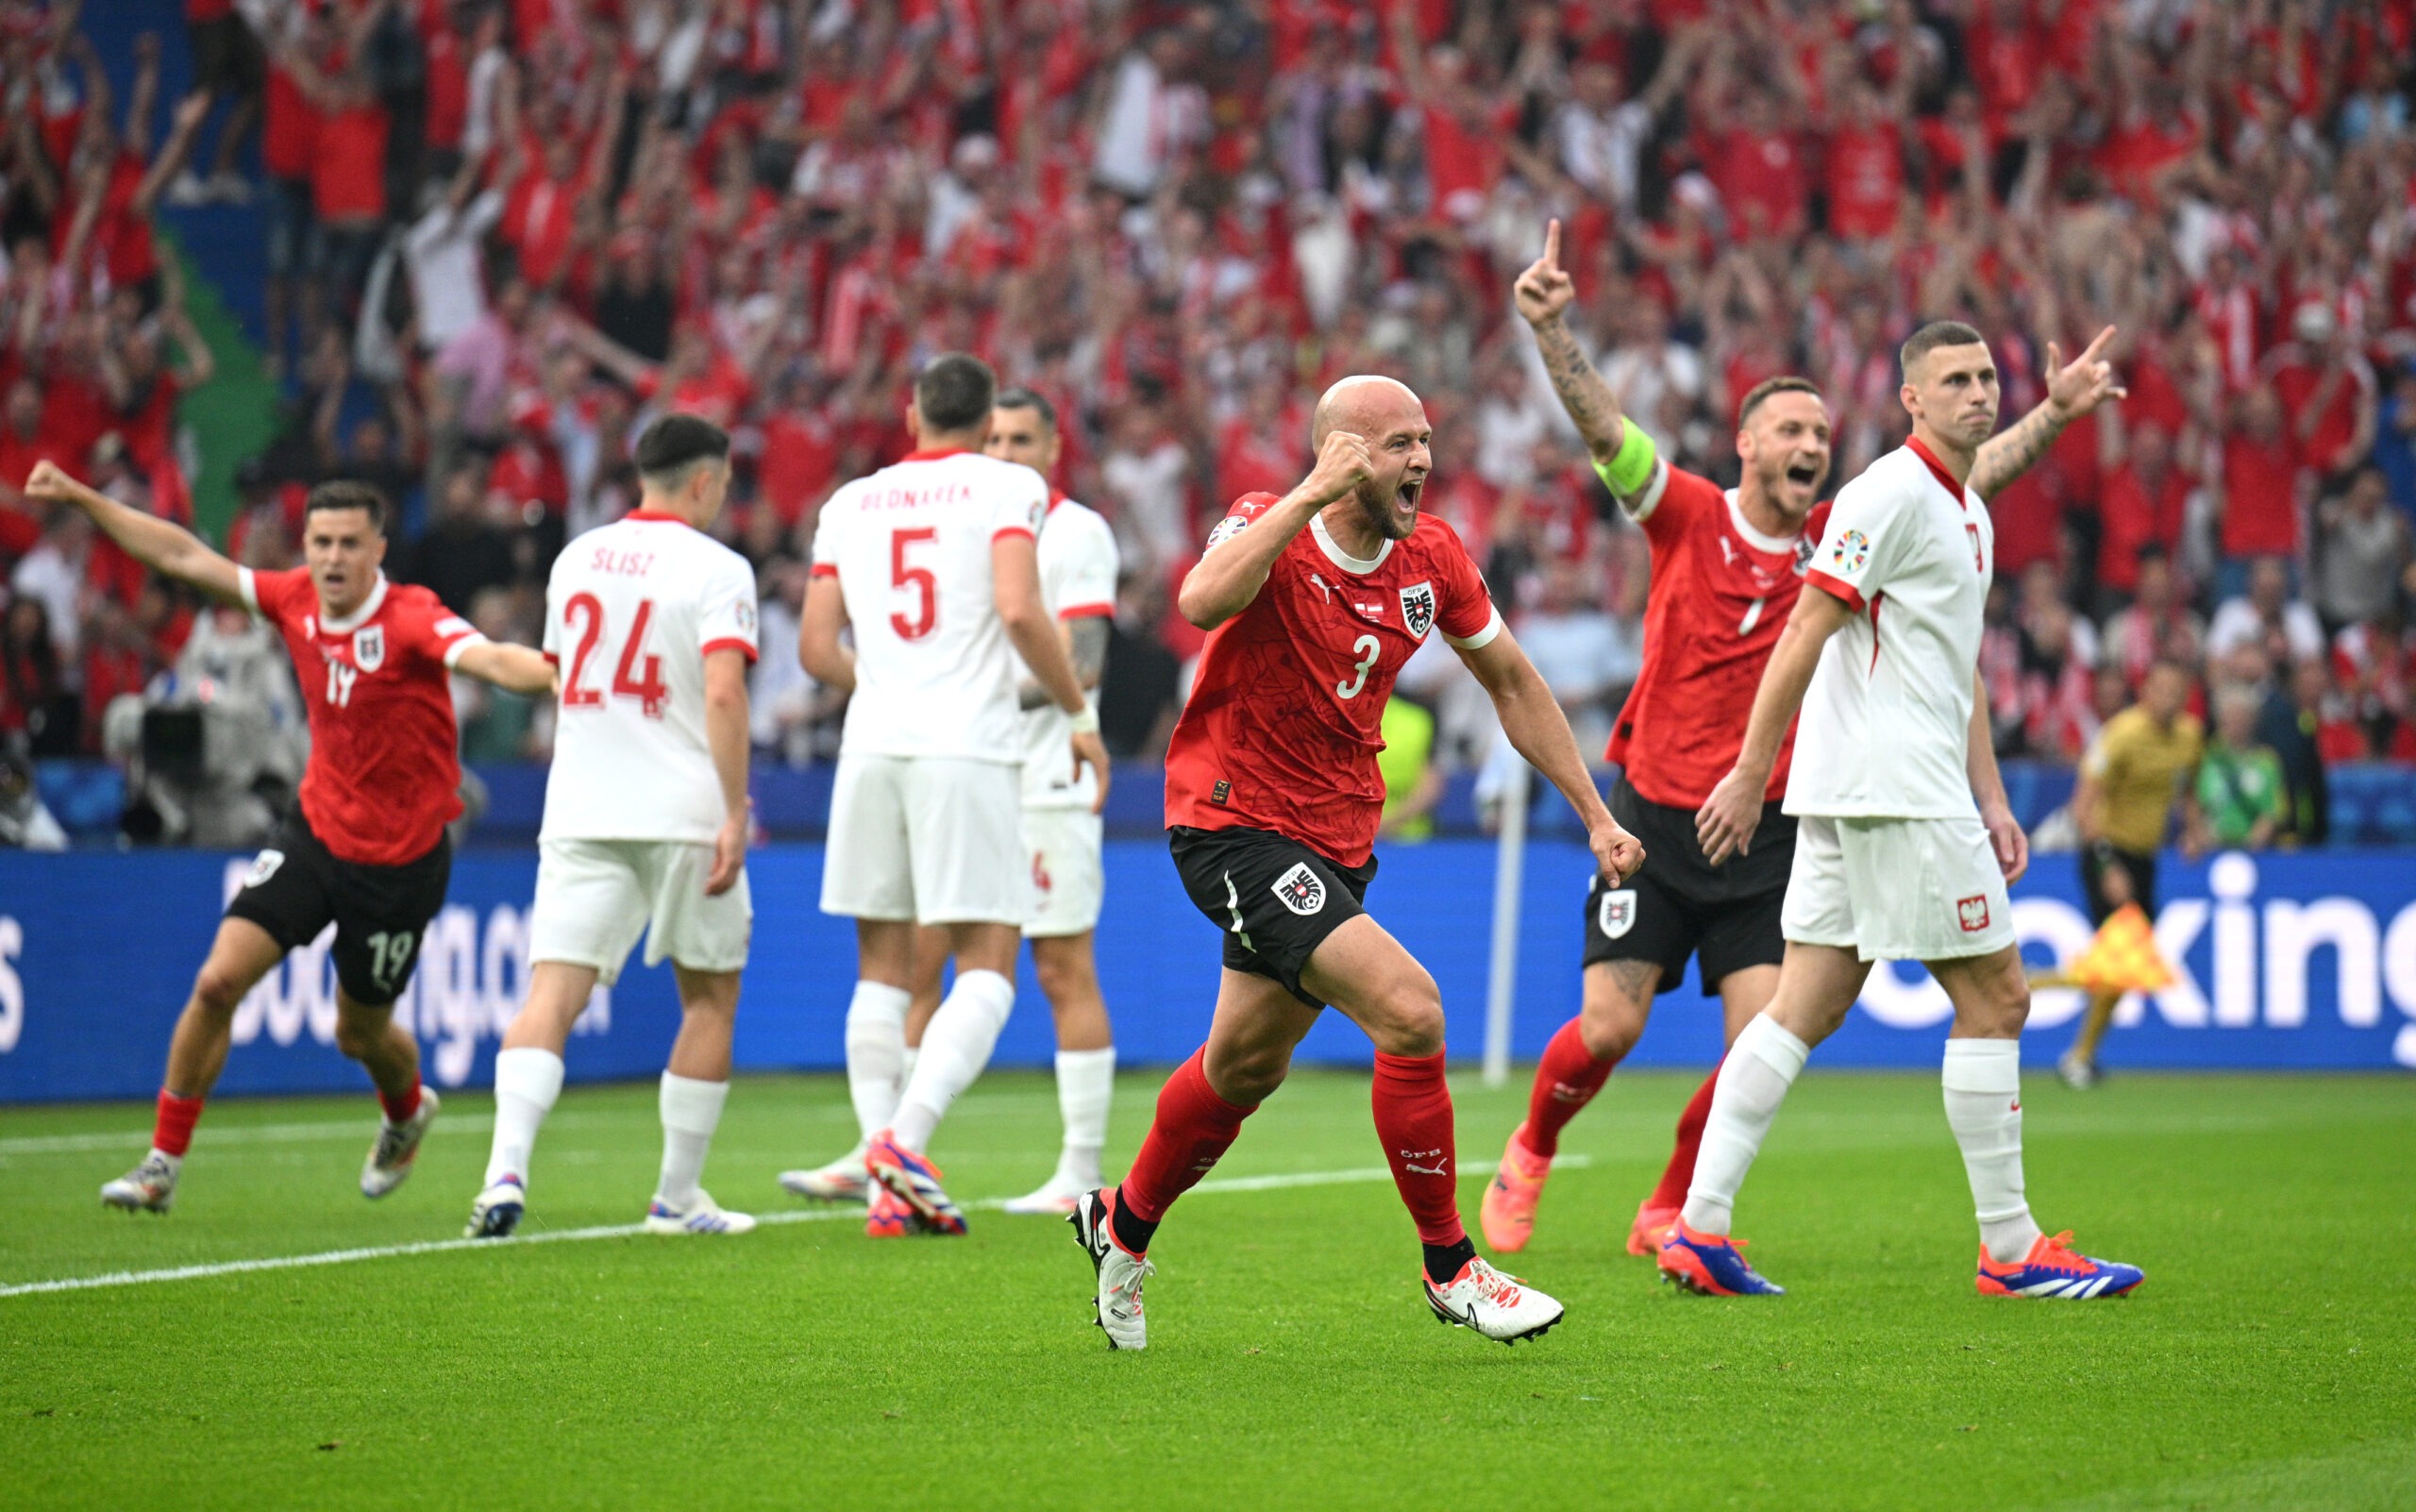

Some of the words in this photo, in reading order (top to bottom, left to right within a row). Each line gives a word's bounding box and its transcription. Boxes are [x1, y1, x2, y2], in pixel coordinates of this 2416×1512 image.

[890, 526, 938, 645] 5
[563, 592, 670, 720] 24
[1336, 634, 1381, 699] 3
[366, 930, 414, 979] 19
